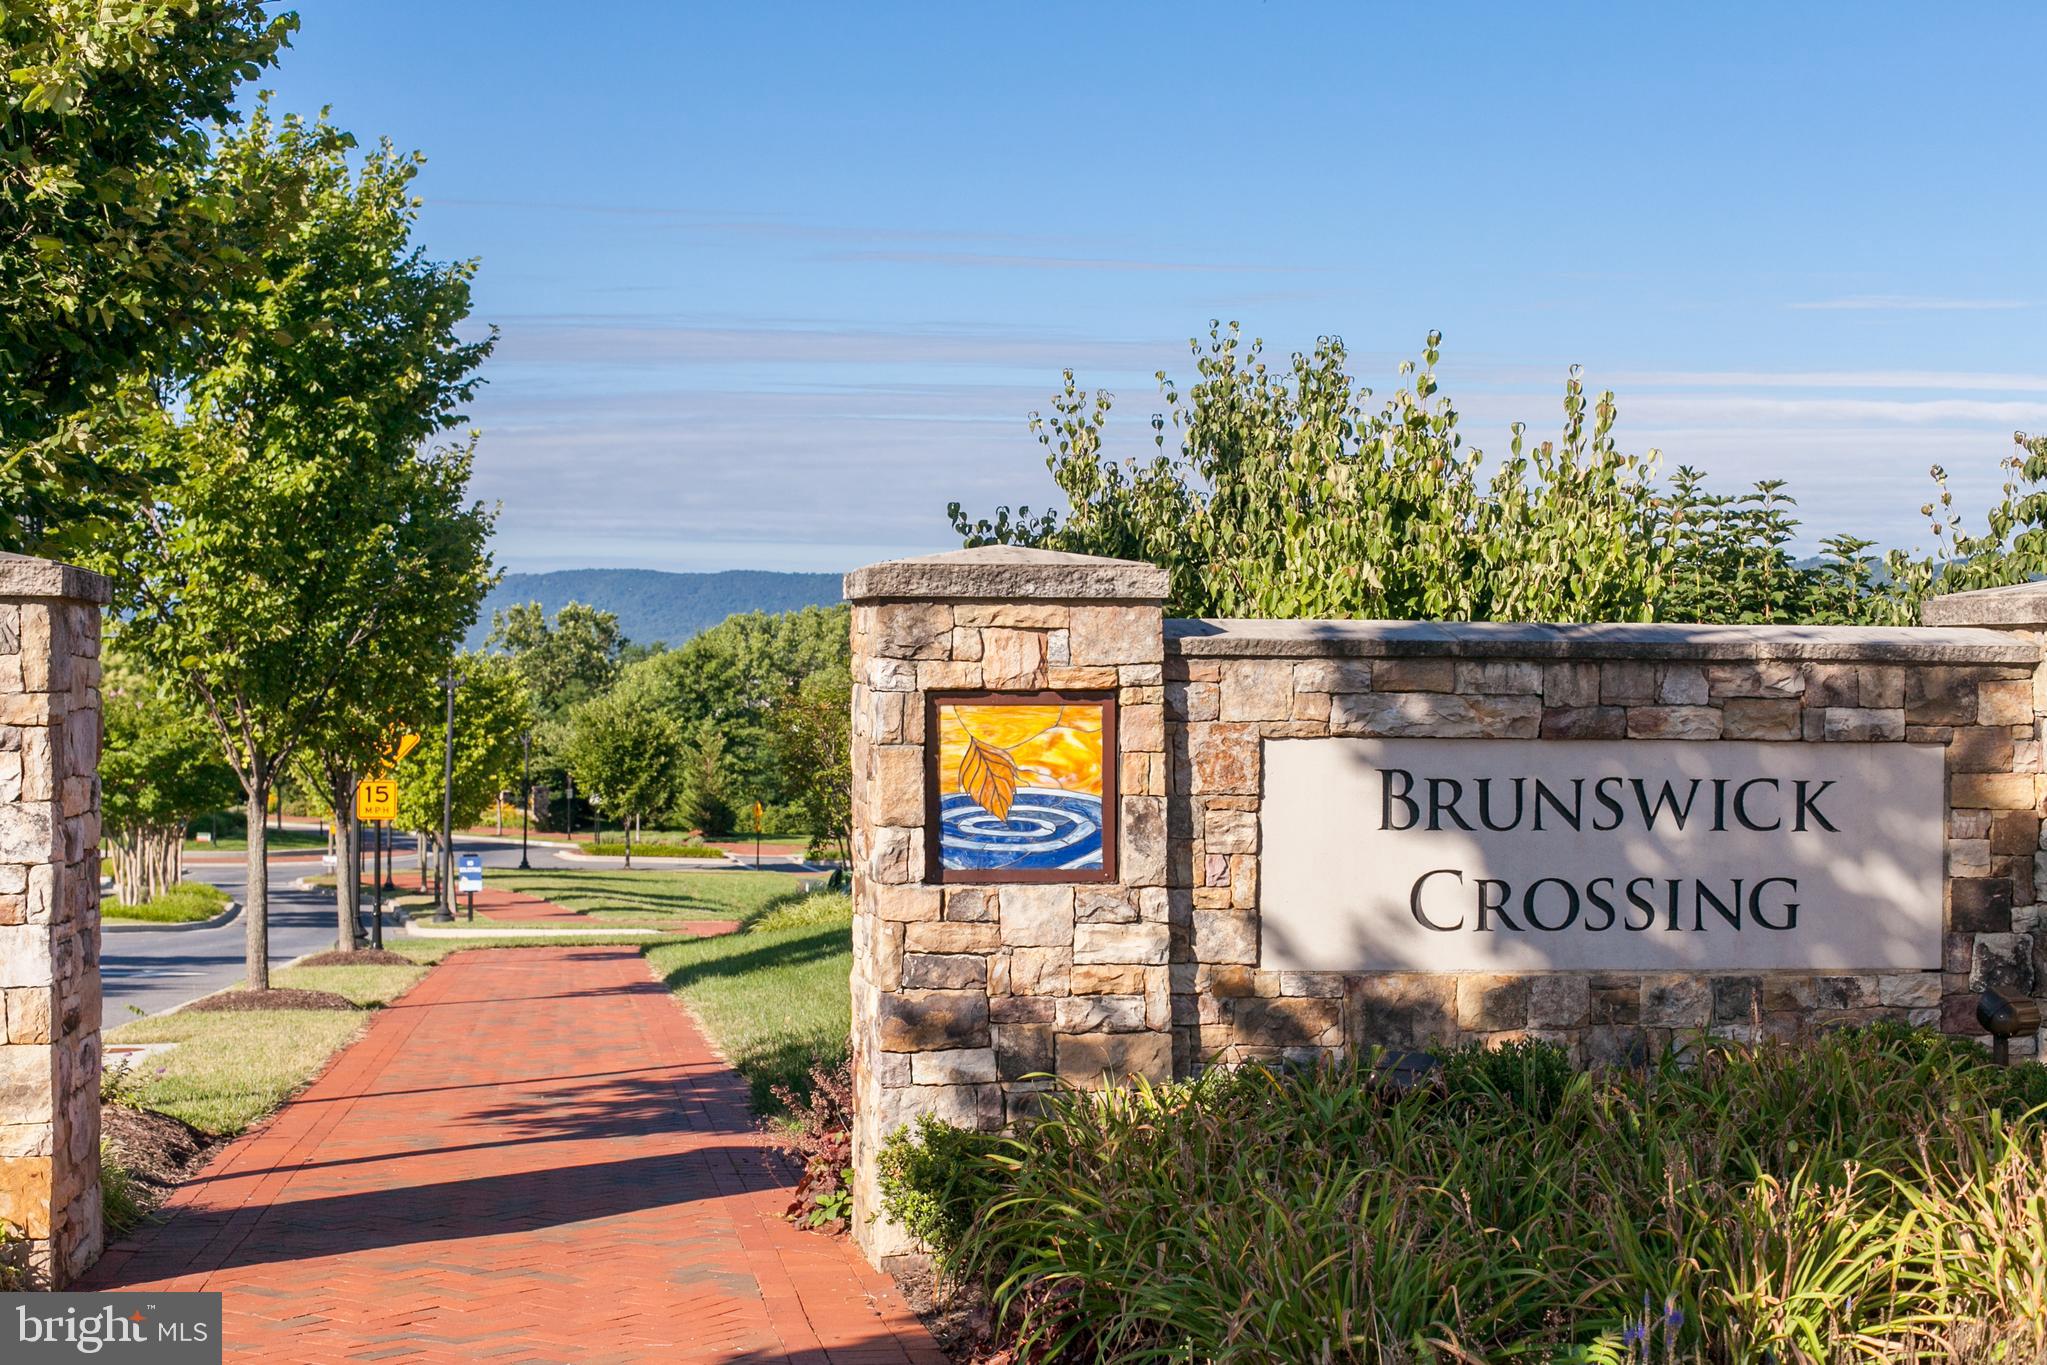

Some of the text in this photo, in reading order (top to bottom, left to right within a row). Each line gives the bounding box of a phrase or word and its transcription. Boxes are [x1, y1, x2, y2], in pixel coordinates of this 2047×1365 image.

[365, 786, 389, 803] 15
[1376, 768, 1841, 833] BRUNSWICK
[1409, 868, 1800, 932] CROSSING
